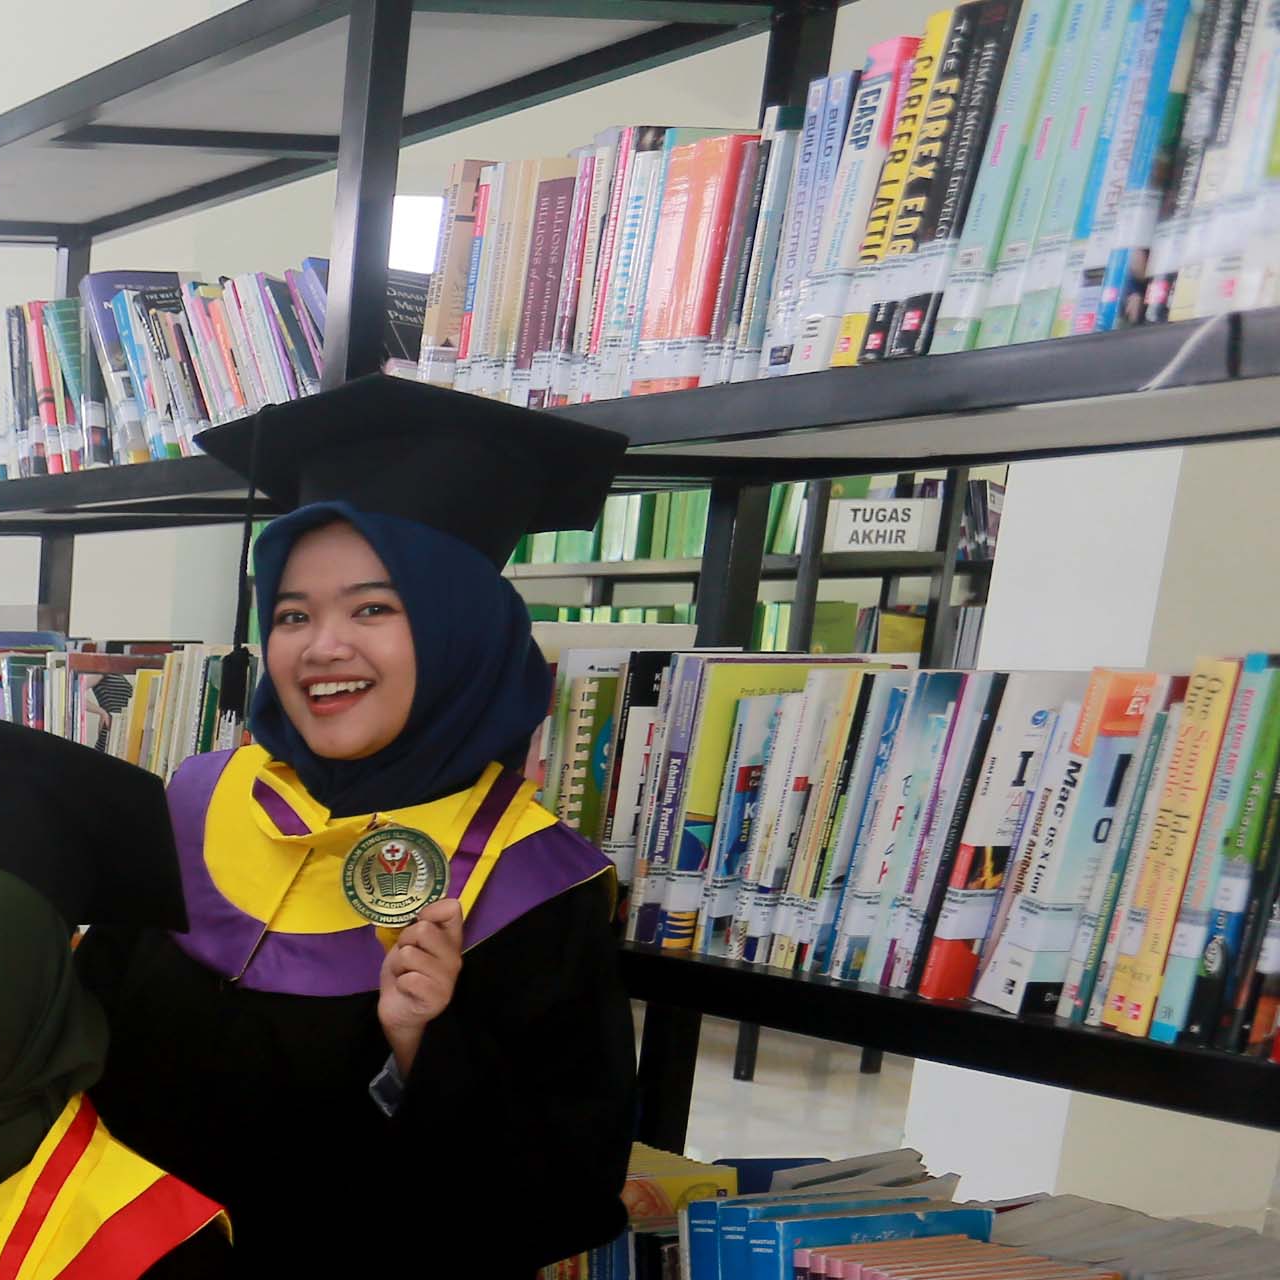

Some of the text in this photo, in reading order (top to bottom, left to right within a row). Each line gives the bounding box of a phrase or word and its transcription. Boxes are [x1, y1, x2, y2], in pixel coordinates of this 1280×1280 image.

[967, 40, 996, 108] HUMAN
[801, 114, 817, 162] BUILD
[821, 107, 838, 157] BUILD
[847, 84, 882, 152] CASP
[888, 16, 968, 259] THE FOREX EDG
[951, 109, 978, 172] MOTOR
[858, 51, 933, 268] CAREER LATTIC
[848, 529, 906, 544] AKHIR
[850, 507, 911, 523] TUGAS
[1198, 674, 1224, 721] One
[1052, 760, 1083, 818] Mac
[1150, 673, 1207, 851] One Simple Idea
[1179, 727, 1212, 804] Simple
[655, 757, 681, 854] Kehamilan, Persalinan,
[1043, 827, 1058, 847] OS
[1166, 812, 1192, 858] Idea
[380, 898, 413, 909] MADIUN
[1028, 863, 1046, 894] Lion
